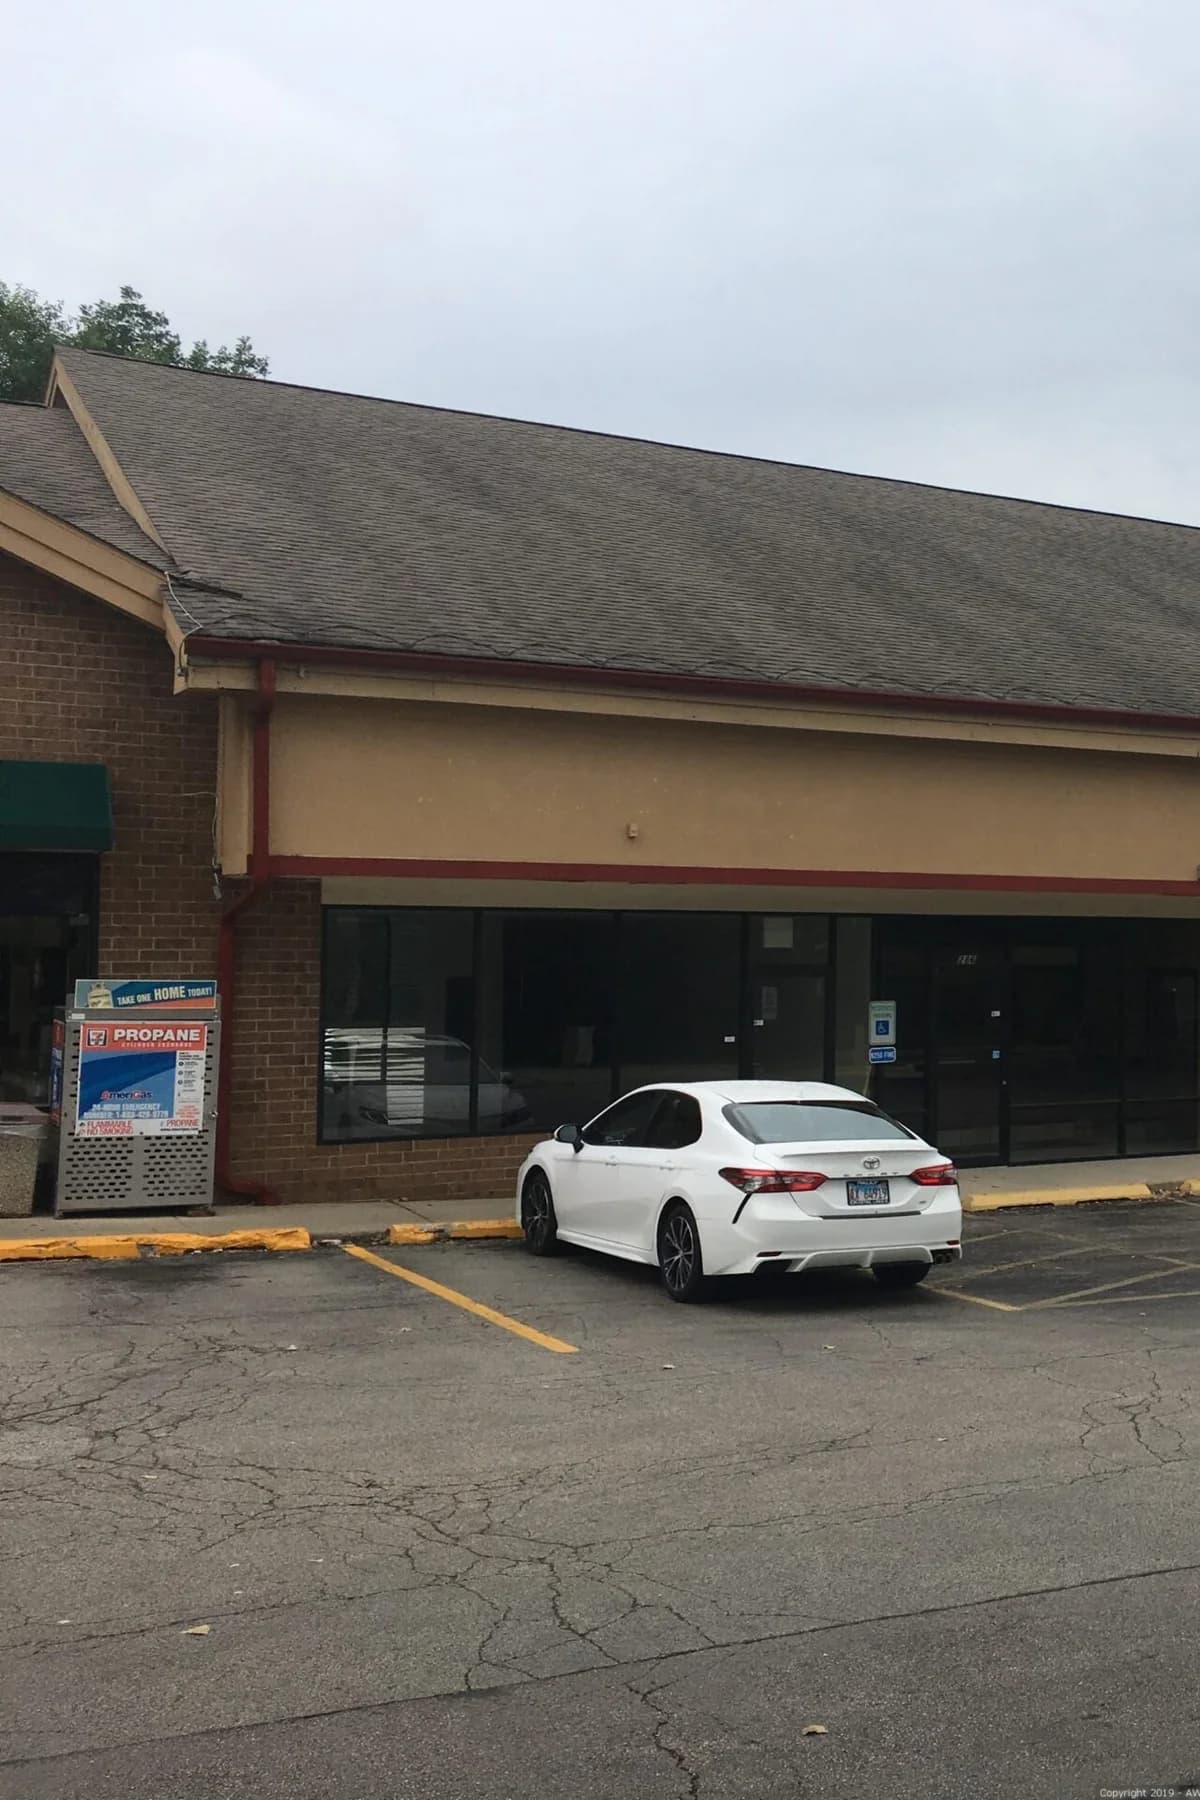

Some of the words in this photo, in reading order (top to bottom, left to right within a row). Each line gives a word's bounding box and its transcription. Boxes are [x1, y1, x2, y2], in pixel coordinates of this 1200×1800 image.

[117, 996, 136, 1006] TAKE
[136, 993, 152, 1002] ONE
[154, 986, 186, 1000] HOME
[187, 987, 213, 997] TODAY!
[113, 1029, 201, 1041] PROPANE
